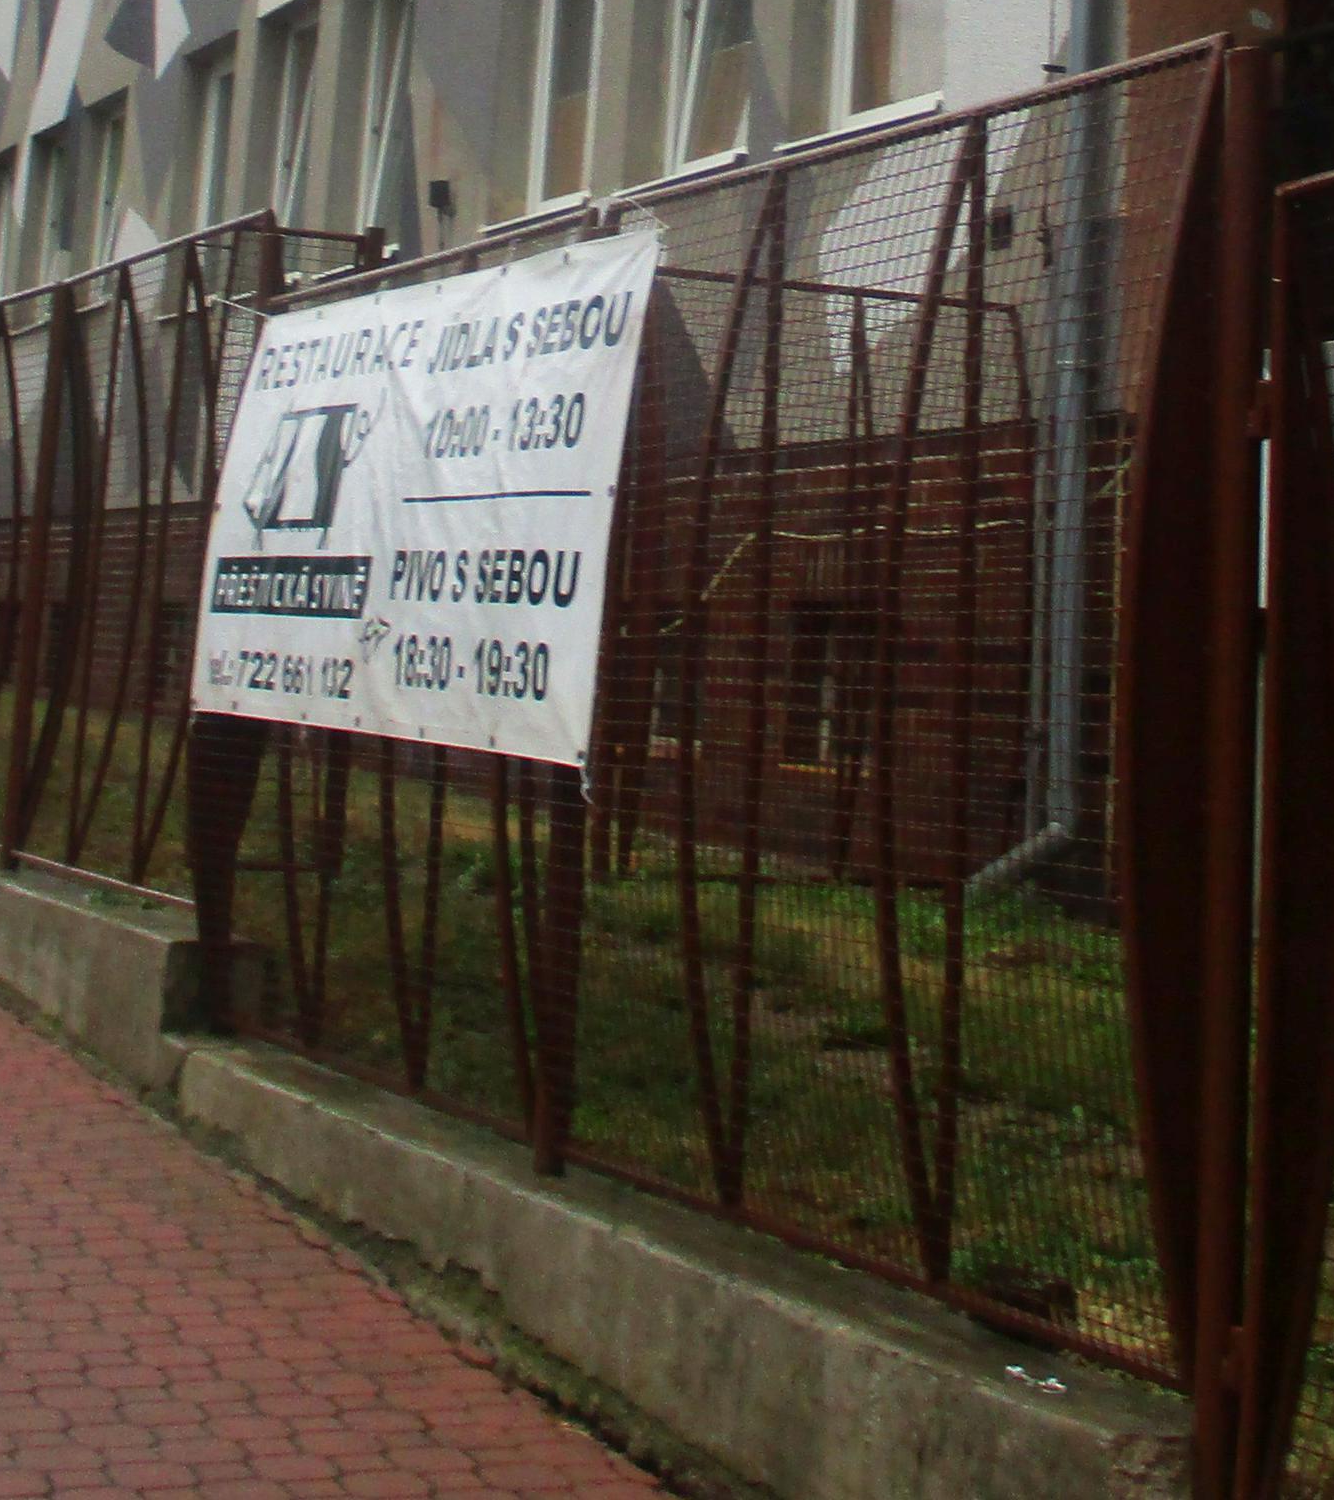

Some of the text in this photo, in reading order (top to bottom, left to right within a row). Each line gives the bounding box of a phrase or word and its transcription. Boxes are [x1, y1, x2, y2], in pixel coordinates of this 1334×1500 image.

[255, 319, 424, 391] RESTAURACE
[502, 311, 525, 362] S
[526, 291, 634, 358] SEBOU
[508, 392, 586, 451] 13:30
[388, 549, 583, 608] PIVO S SEBOU
[236, 650, 279, 691] 722
[394, 634, 452, 691] 18:30
[474, 636, 549, 701] 19:30
